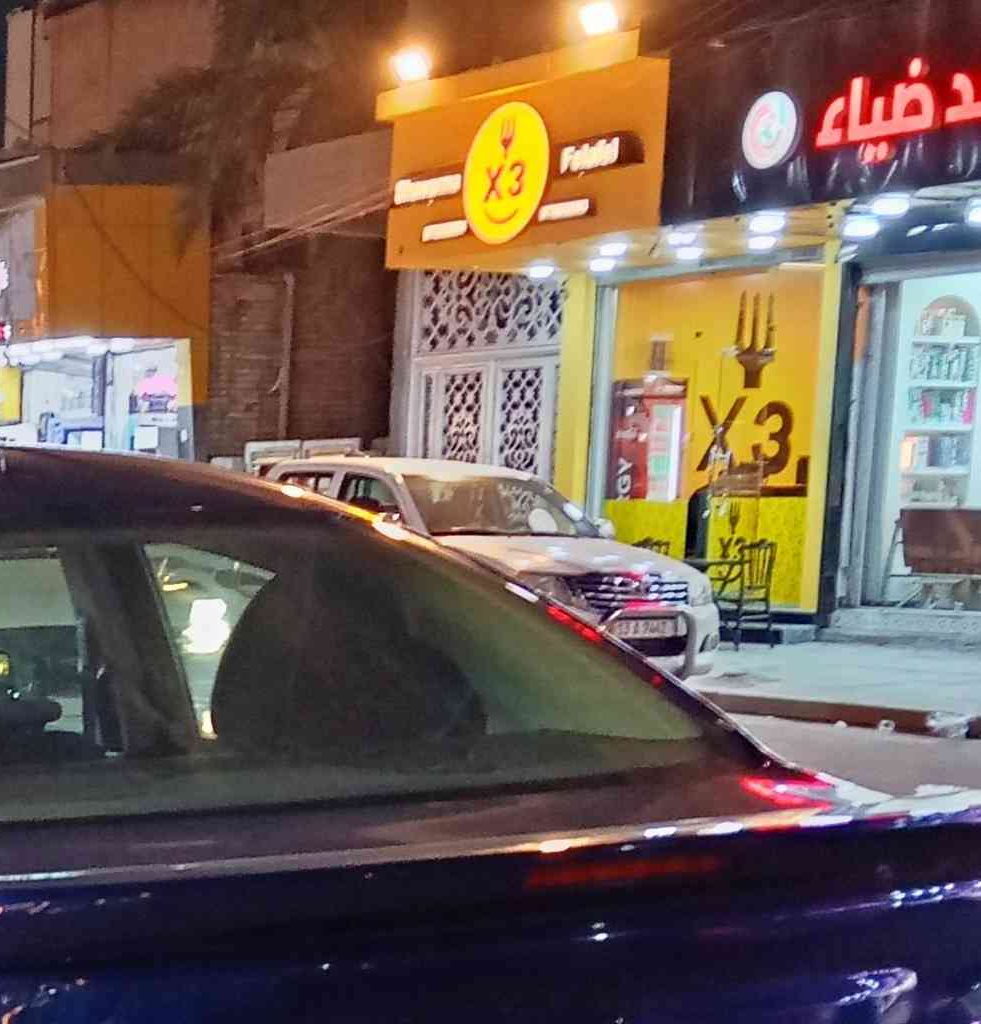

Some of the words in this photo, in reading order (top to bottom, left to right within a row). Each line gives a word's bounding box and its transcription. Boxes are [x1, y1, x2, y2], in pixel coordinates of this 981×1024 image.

[815, 57, 935, 165] ضياء
[484, 162, 526, 203] X3
[695, 396, 796, 478] X3
[617, 457, 634, 501] GY
